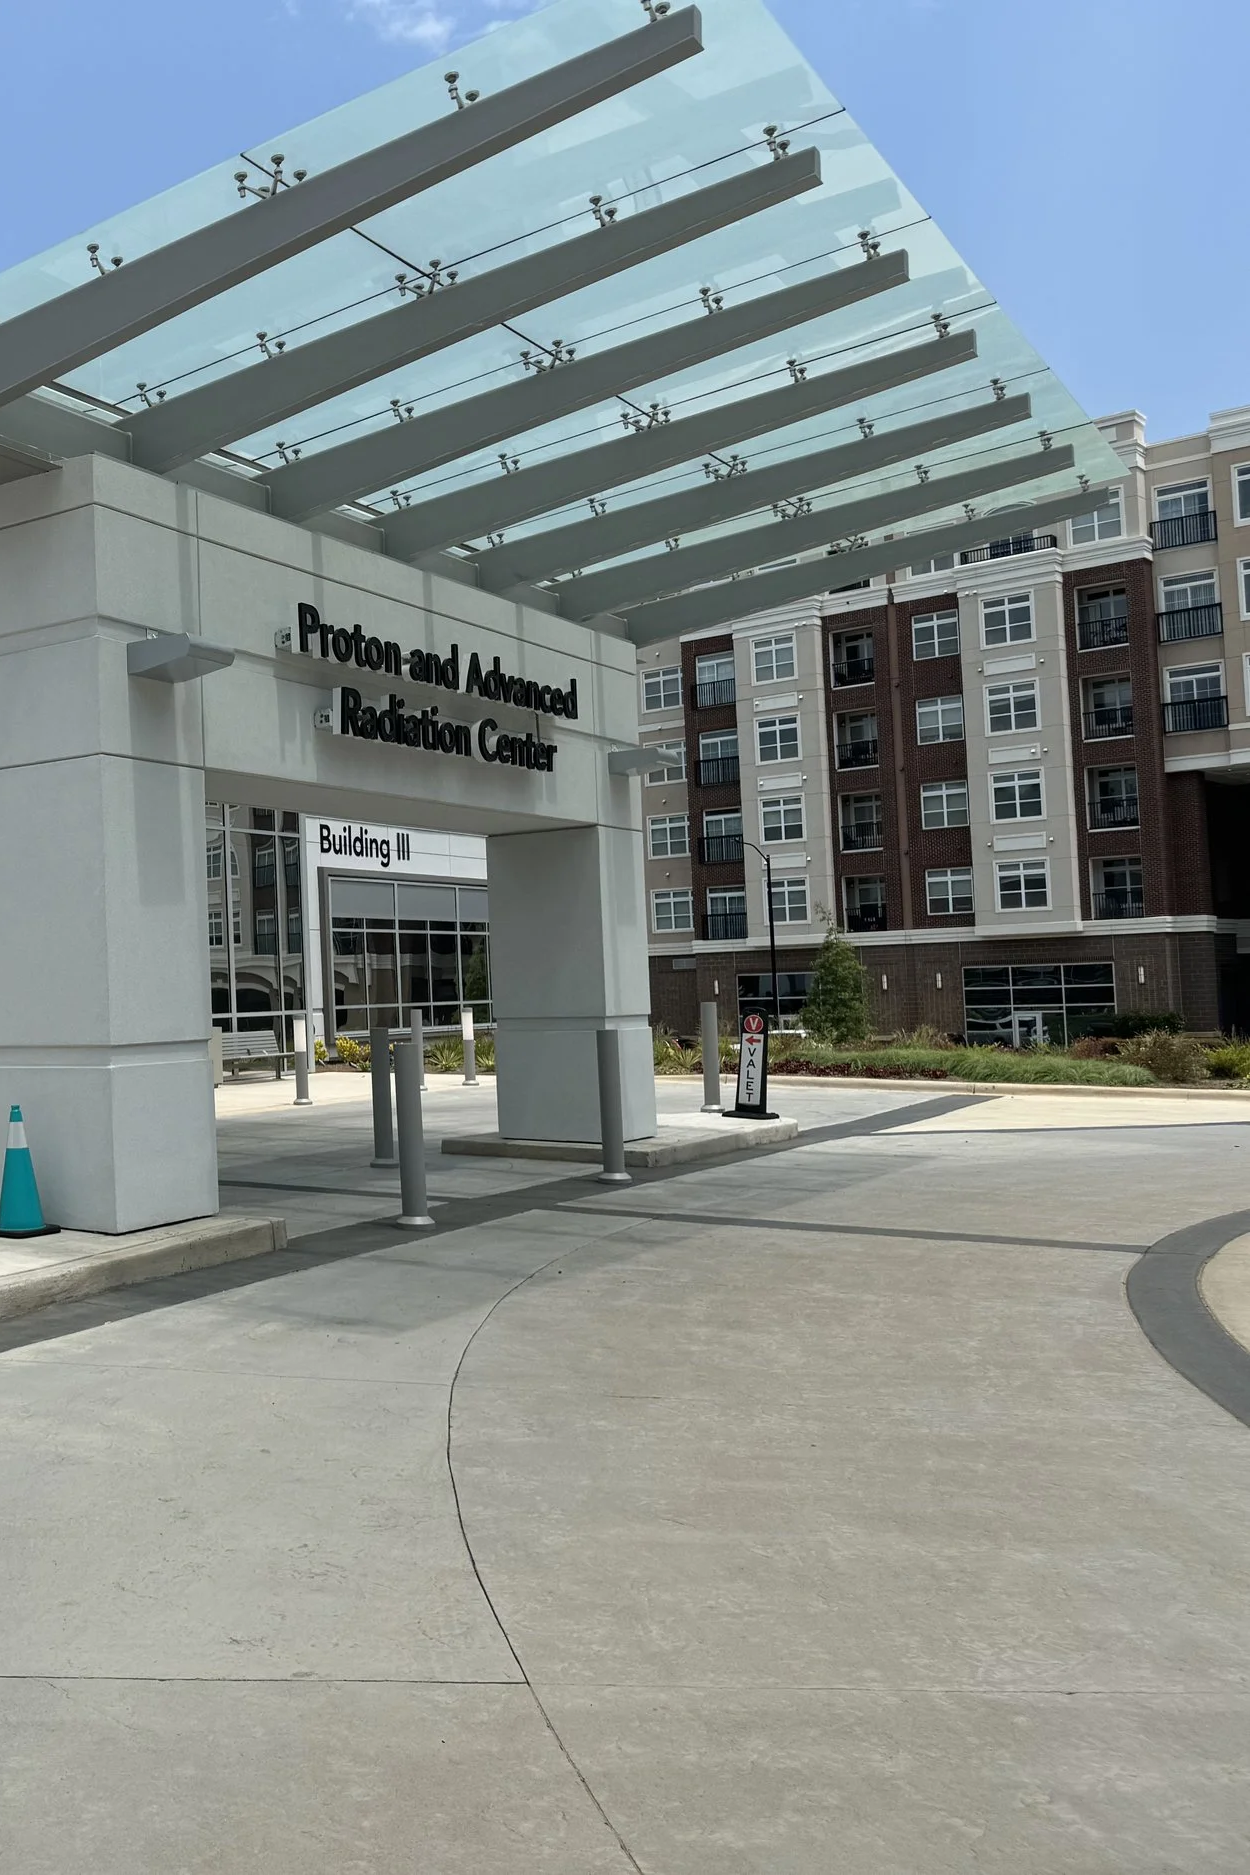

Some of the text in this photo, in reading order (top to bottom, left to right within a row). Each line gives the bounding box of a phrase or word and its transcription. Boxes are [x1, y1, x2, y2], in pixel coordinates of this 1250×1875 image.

[297, 602, 579, 720] Proton and Advanced
[340, 686, 558, 772] Radiation Center
[319, 823, 411, 868] Building III
[749, 1018, 759, 1031] V
[746, 1047, 757, 1103] VALET
